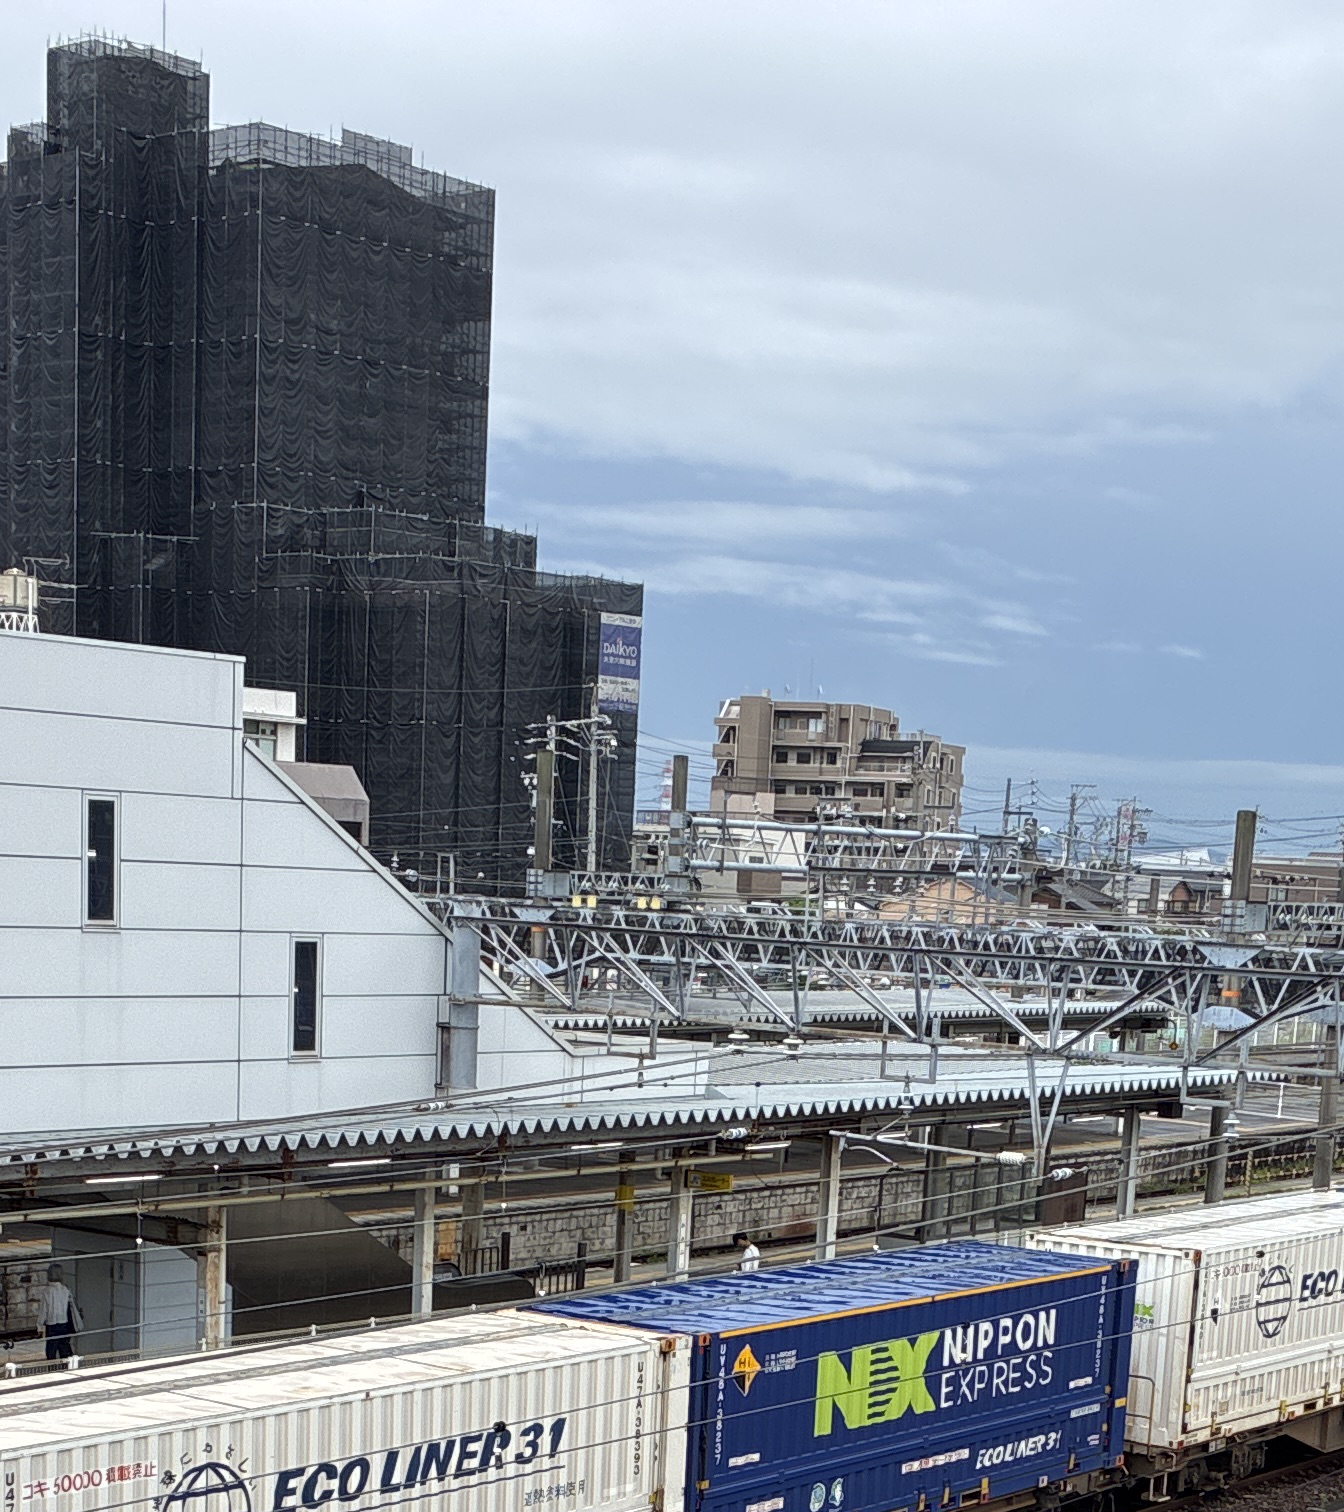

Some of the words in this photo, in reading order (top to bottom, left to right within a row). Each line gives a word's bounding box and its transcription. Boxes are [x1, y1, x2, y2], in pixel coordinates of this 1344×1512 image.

[603, 638, 638, 657] DAIKYO
[1299, 1269, 1338, 1303] ECO
[814, 1331, 940, 1438] NX
[942, 1309, 1056, 1367] NIPPON
[939, 1350, 1053, 1409] EXPRESS
[634, 1362, 644, 1475] U47A-38393
[380, 1428, 512, 1495] LINER
[514, 1417, 567, 1465] 31
[975, 1448, 1003, 1470] ECO
[1045, 1430, 1062, 1451] 31
[22, 1481, 50, 1500] コキ
